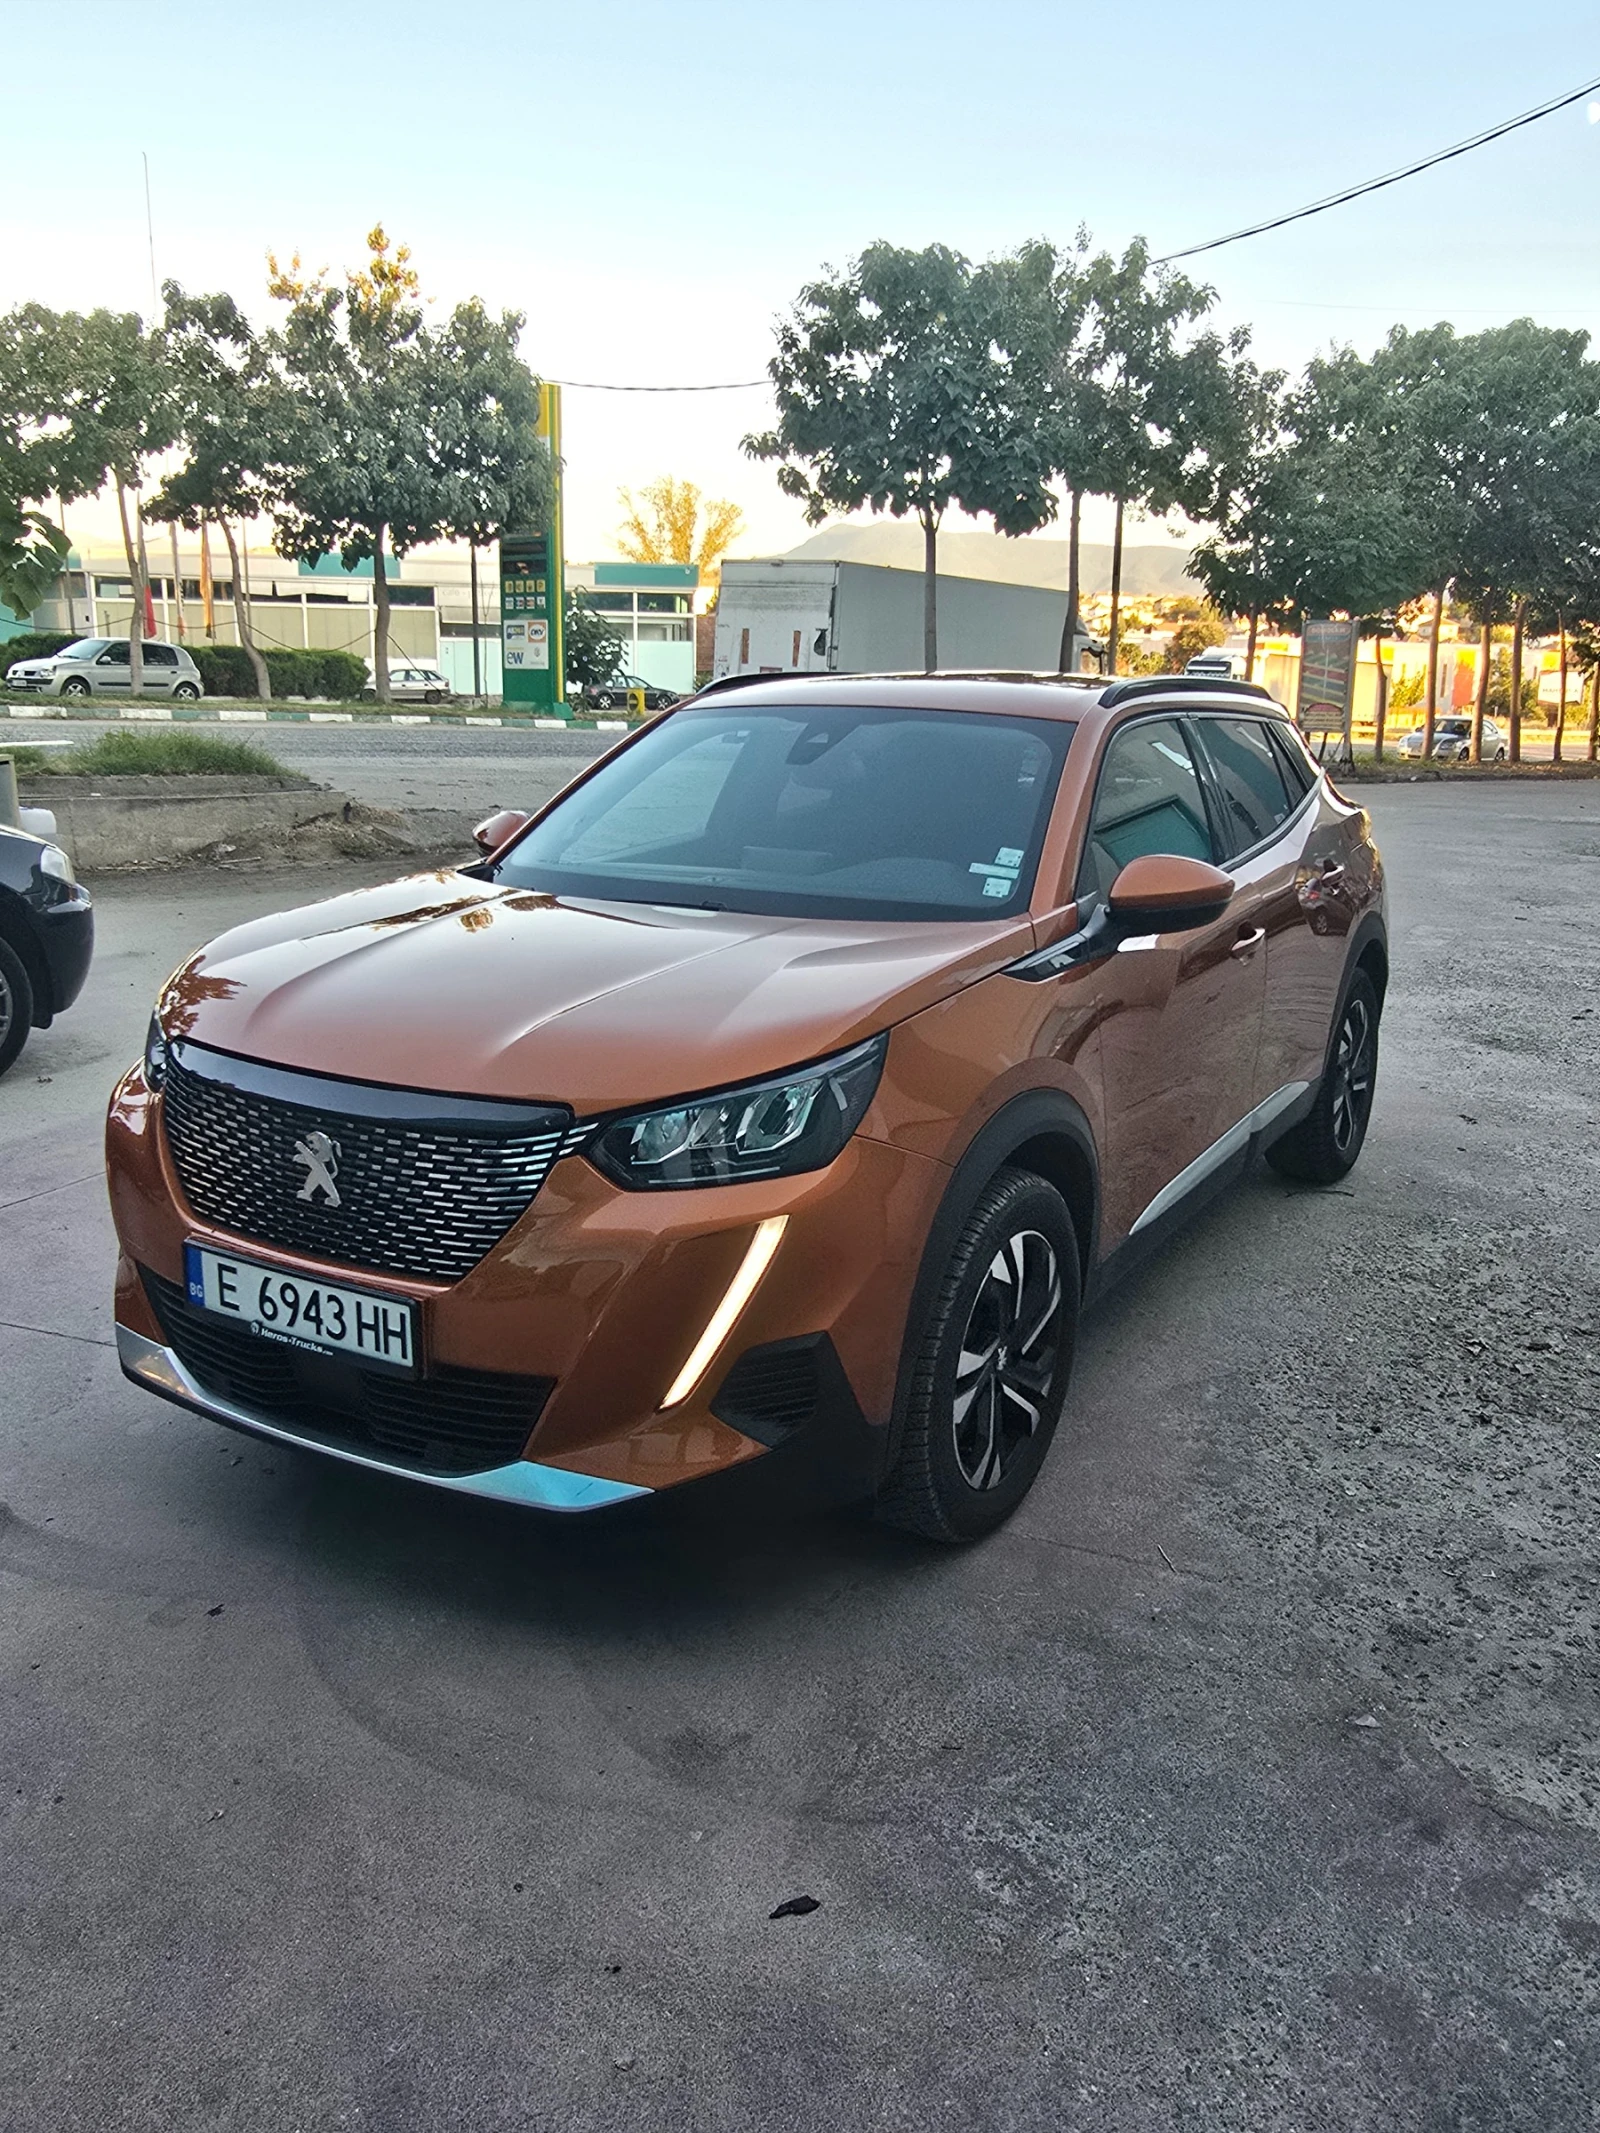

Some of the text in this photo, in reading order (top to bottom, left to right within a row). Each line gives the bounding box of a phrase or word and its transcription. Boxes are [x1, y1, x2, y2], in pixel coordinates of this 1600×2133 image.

[189, 1263, 408, 1360] BG E 6943 HH
